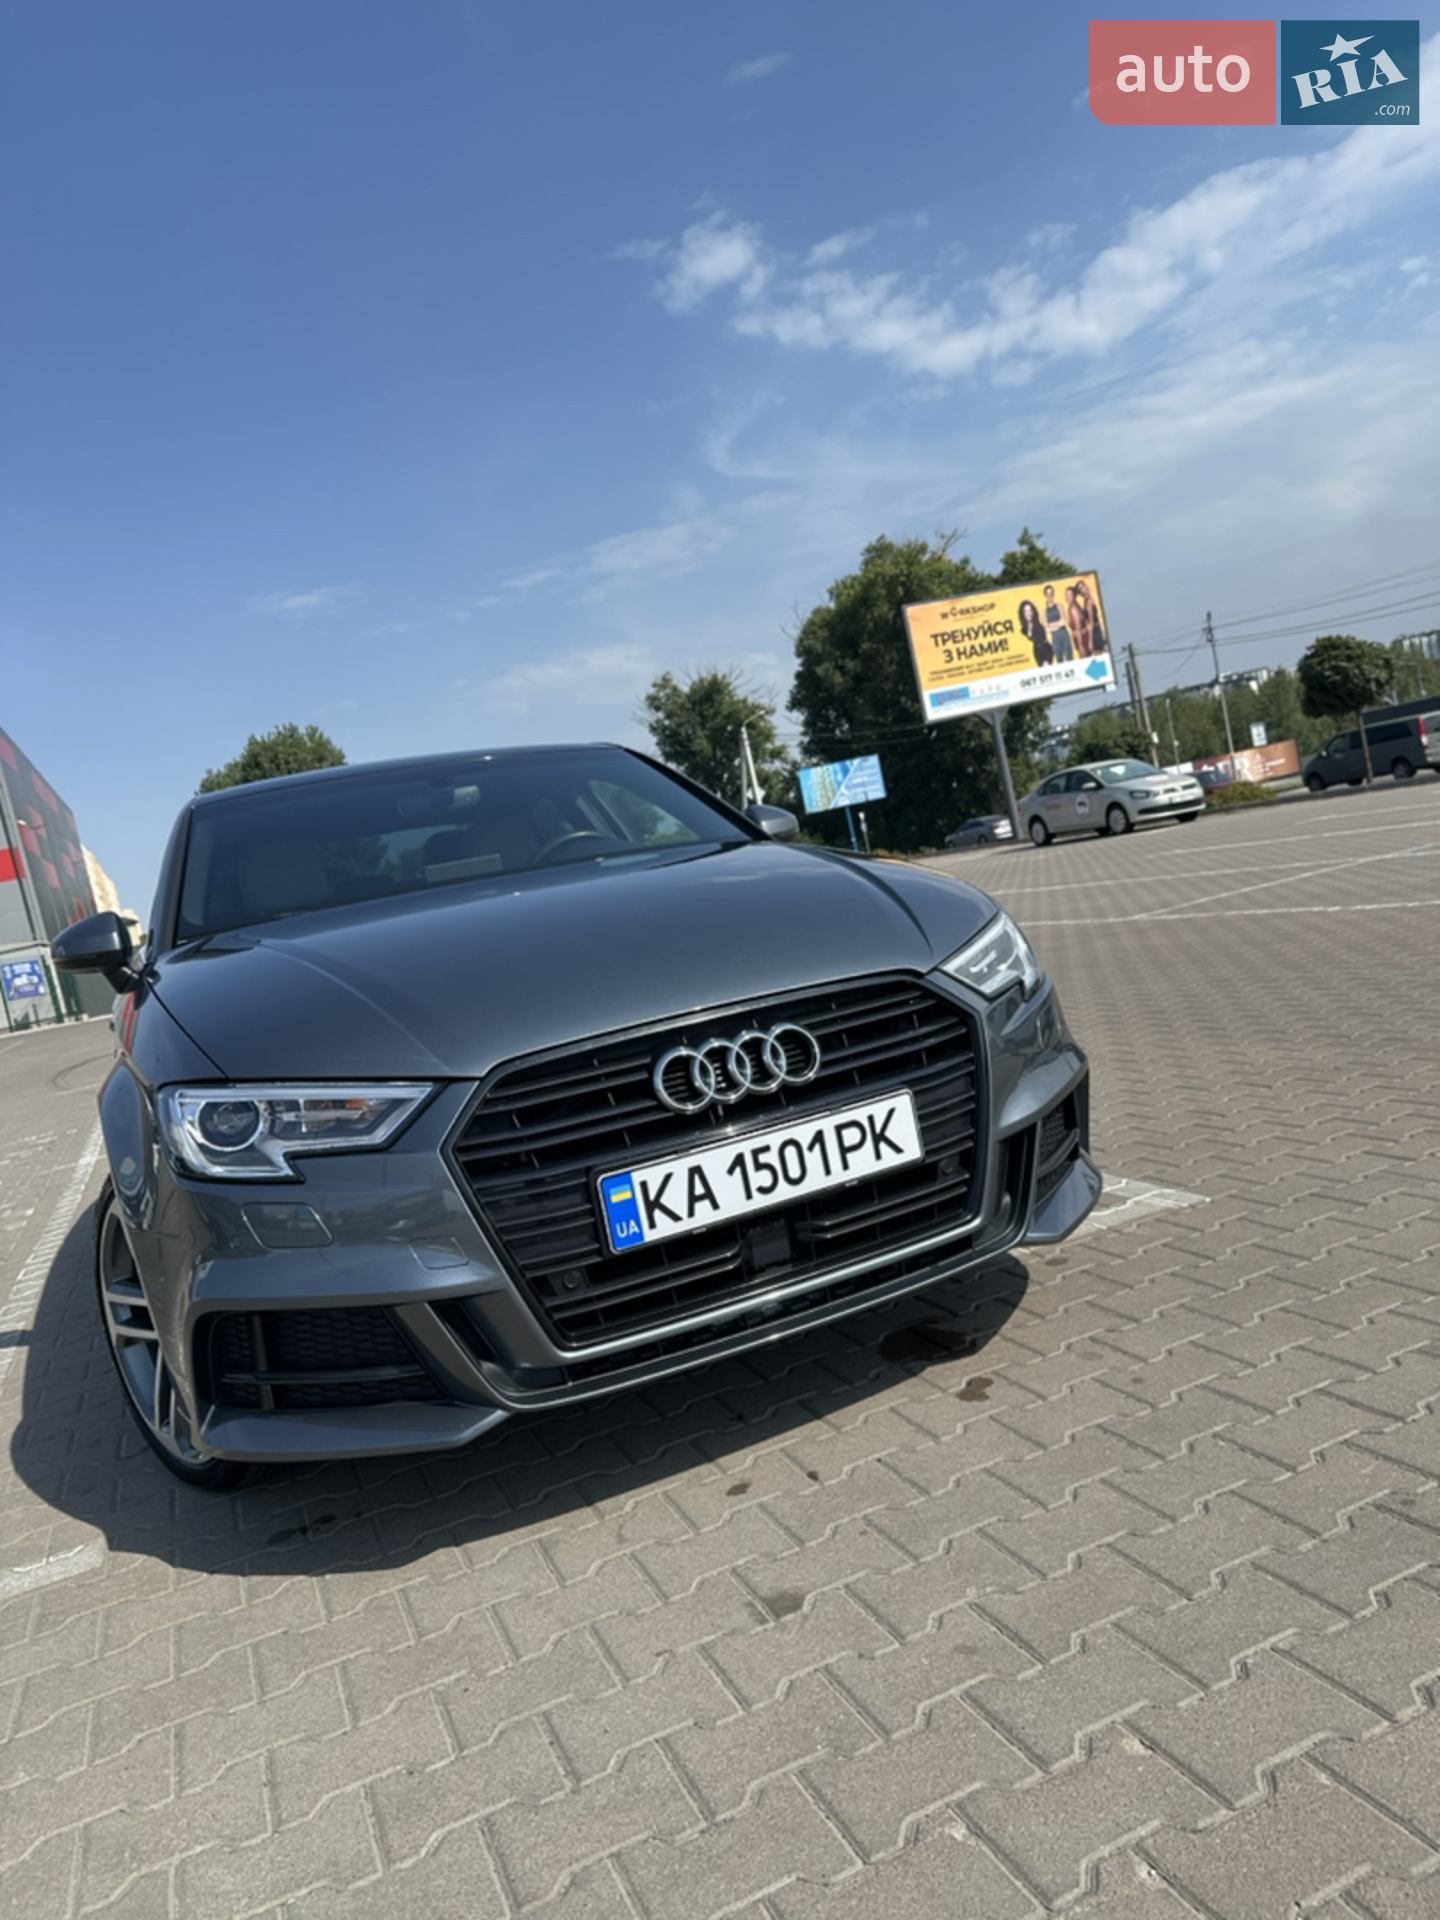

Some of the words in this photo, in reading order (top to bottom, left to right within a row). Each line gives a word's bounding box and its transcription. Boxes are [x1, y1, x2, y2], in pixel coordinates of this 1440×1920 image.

[930, 619, 1014, 647] ТРЕНУЙСЯ
[956, 638, 1009, 660] НАМИ!
[639, 1164, 720, 1230] KA
[616, 1219, 640, 1239] UA
